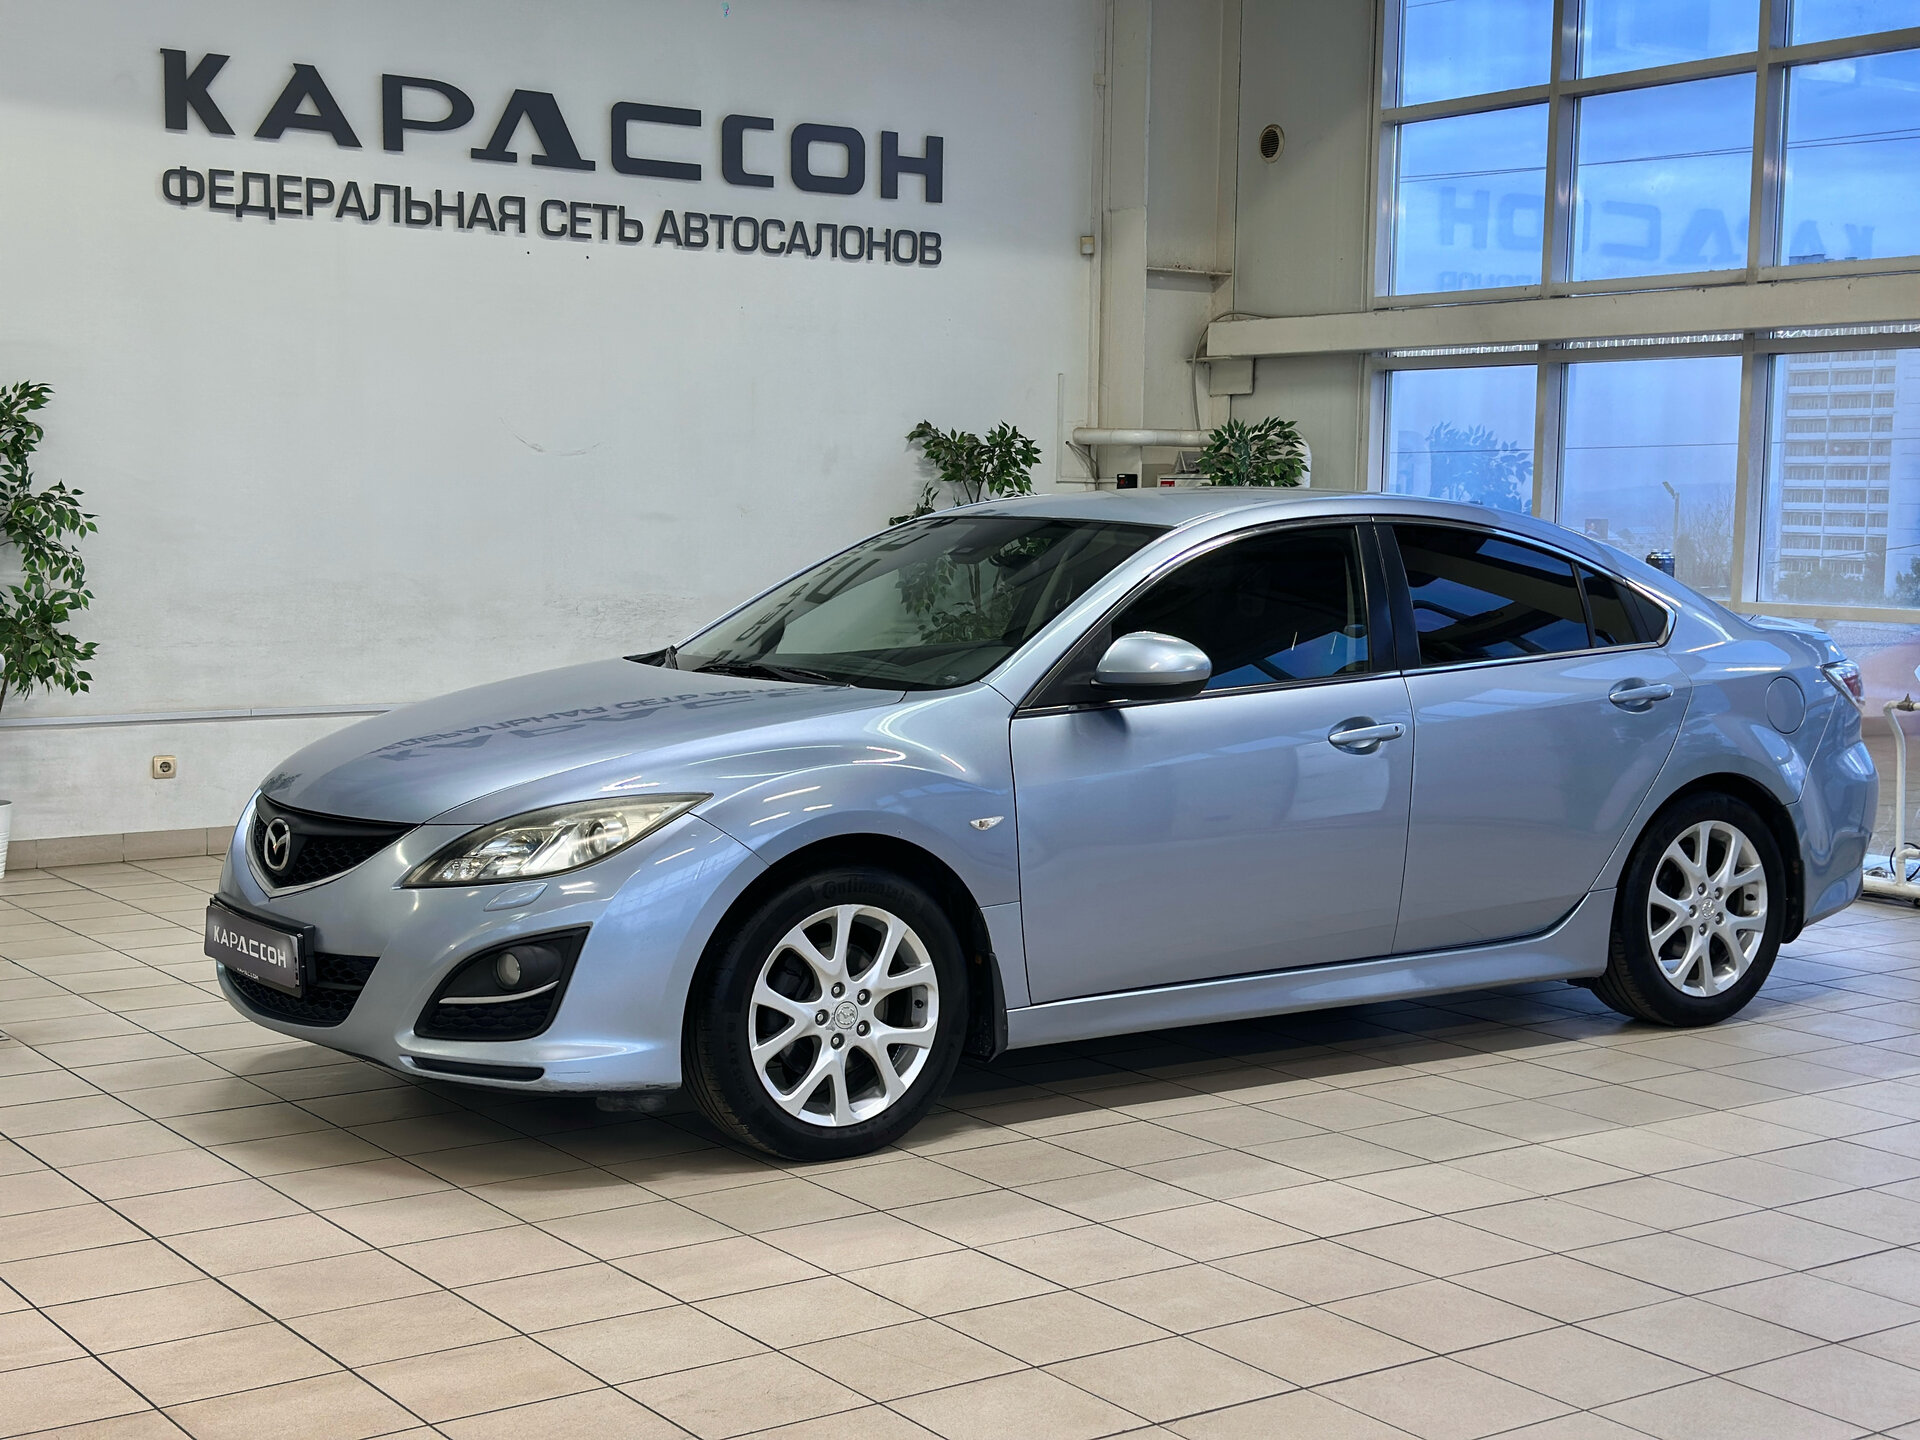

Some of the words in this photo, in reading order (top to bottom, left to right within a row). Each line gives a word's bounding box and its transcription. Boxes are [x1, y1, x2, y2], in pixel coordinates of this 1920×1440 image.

[162, 165, 526, 234] ФЕДЕРАЛЬНАЯ
[540, 199, 644, 243] СЕТЬ
[654, 209, 942, 264] АВТОСАЛОНОВ
